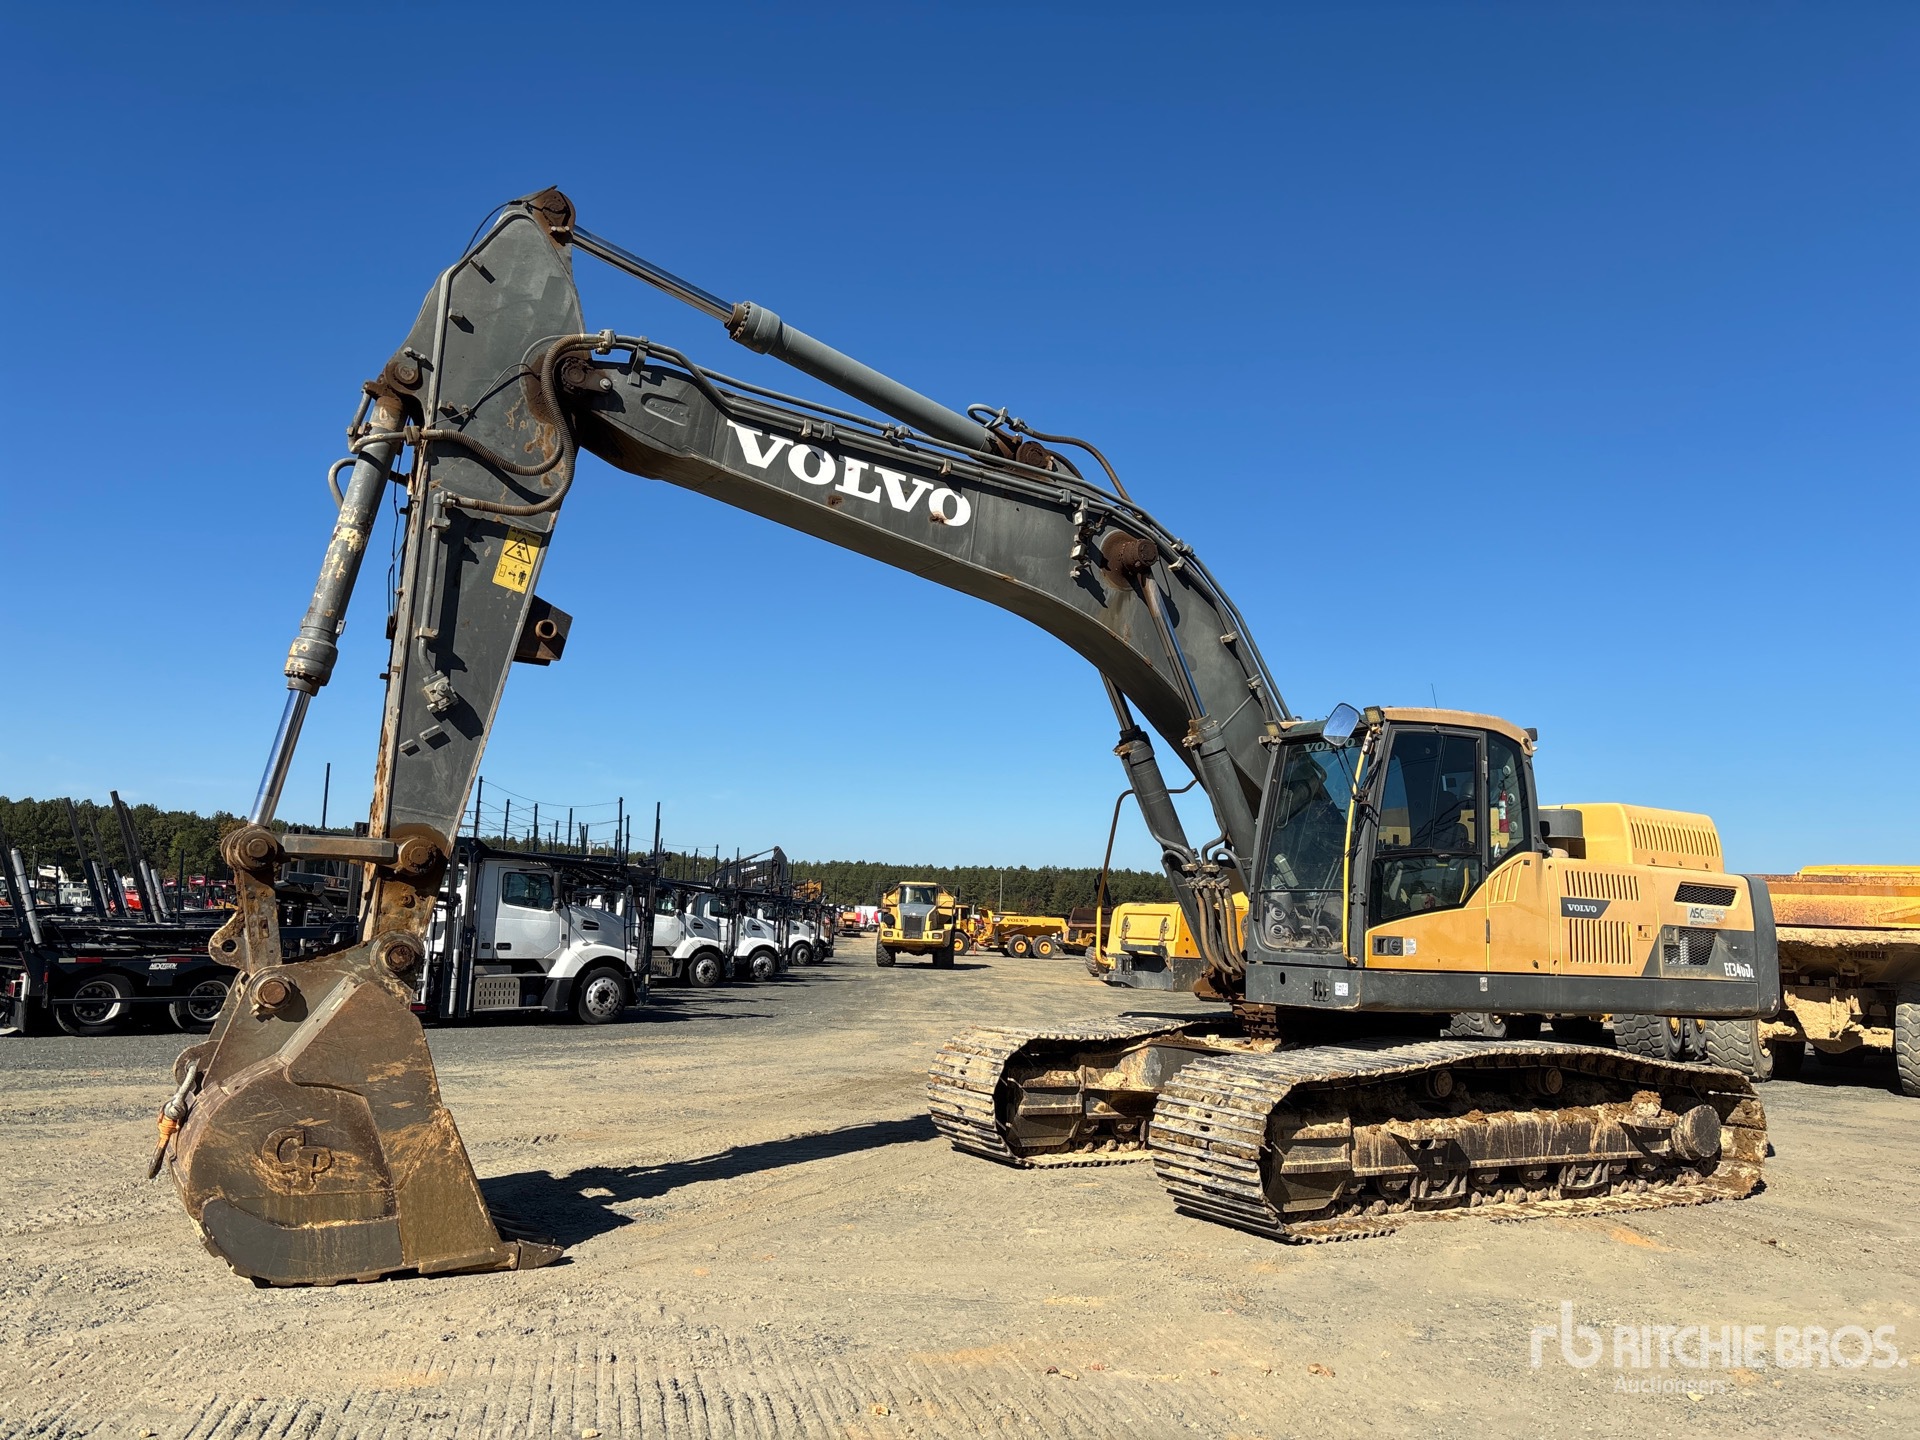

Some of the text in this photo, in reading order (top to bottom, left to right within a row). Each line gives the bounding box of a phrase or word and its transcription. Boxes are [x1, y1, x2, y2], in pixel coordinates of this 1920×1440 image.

[727, 419, 971, 527] VOLVO
[1303, 737, 1356, 753] VOLO
[1566, 903, 1597, 913] VOLVO
[1689, 907, 1705, 919] ASC
